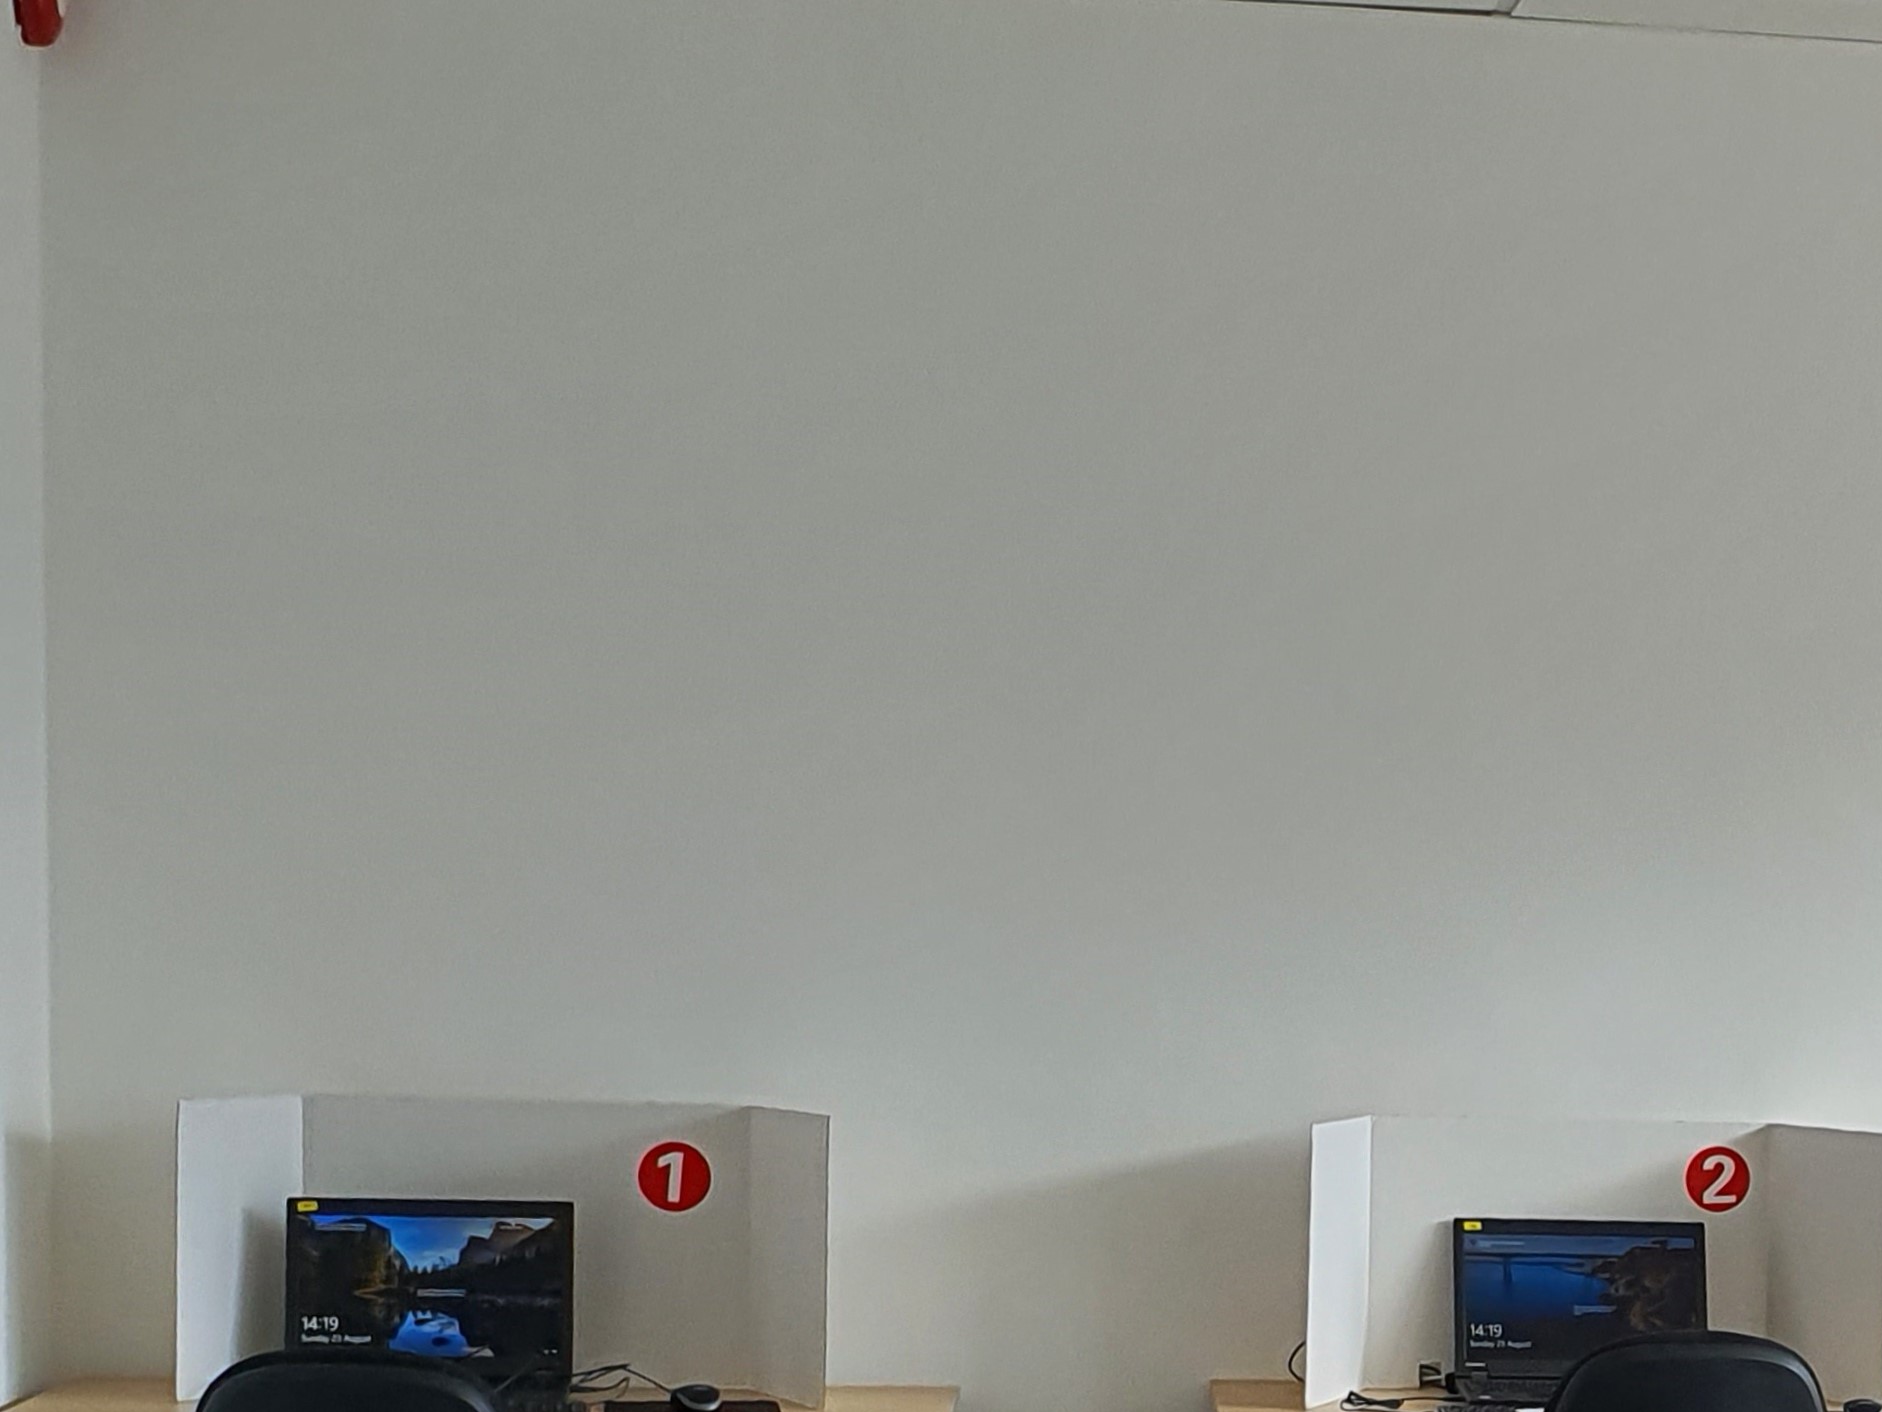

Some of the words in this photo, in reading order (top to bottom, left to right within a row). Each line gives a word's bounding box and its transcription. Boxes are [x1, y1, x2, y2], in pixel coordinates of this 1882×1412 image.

[657, 1151, 684, 1203] 1
[1702, 1154, 1737, 1204] 2
[301, 1316, 339, 1332] 14:19
[1470, 1323, 1503, 1338] 14:19
